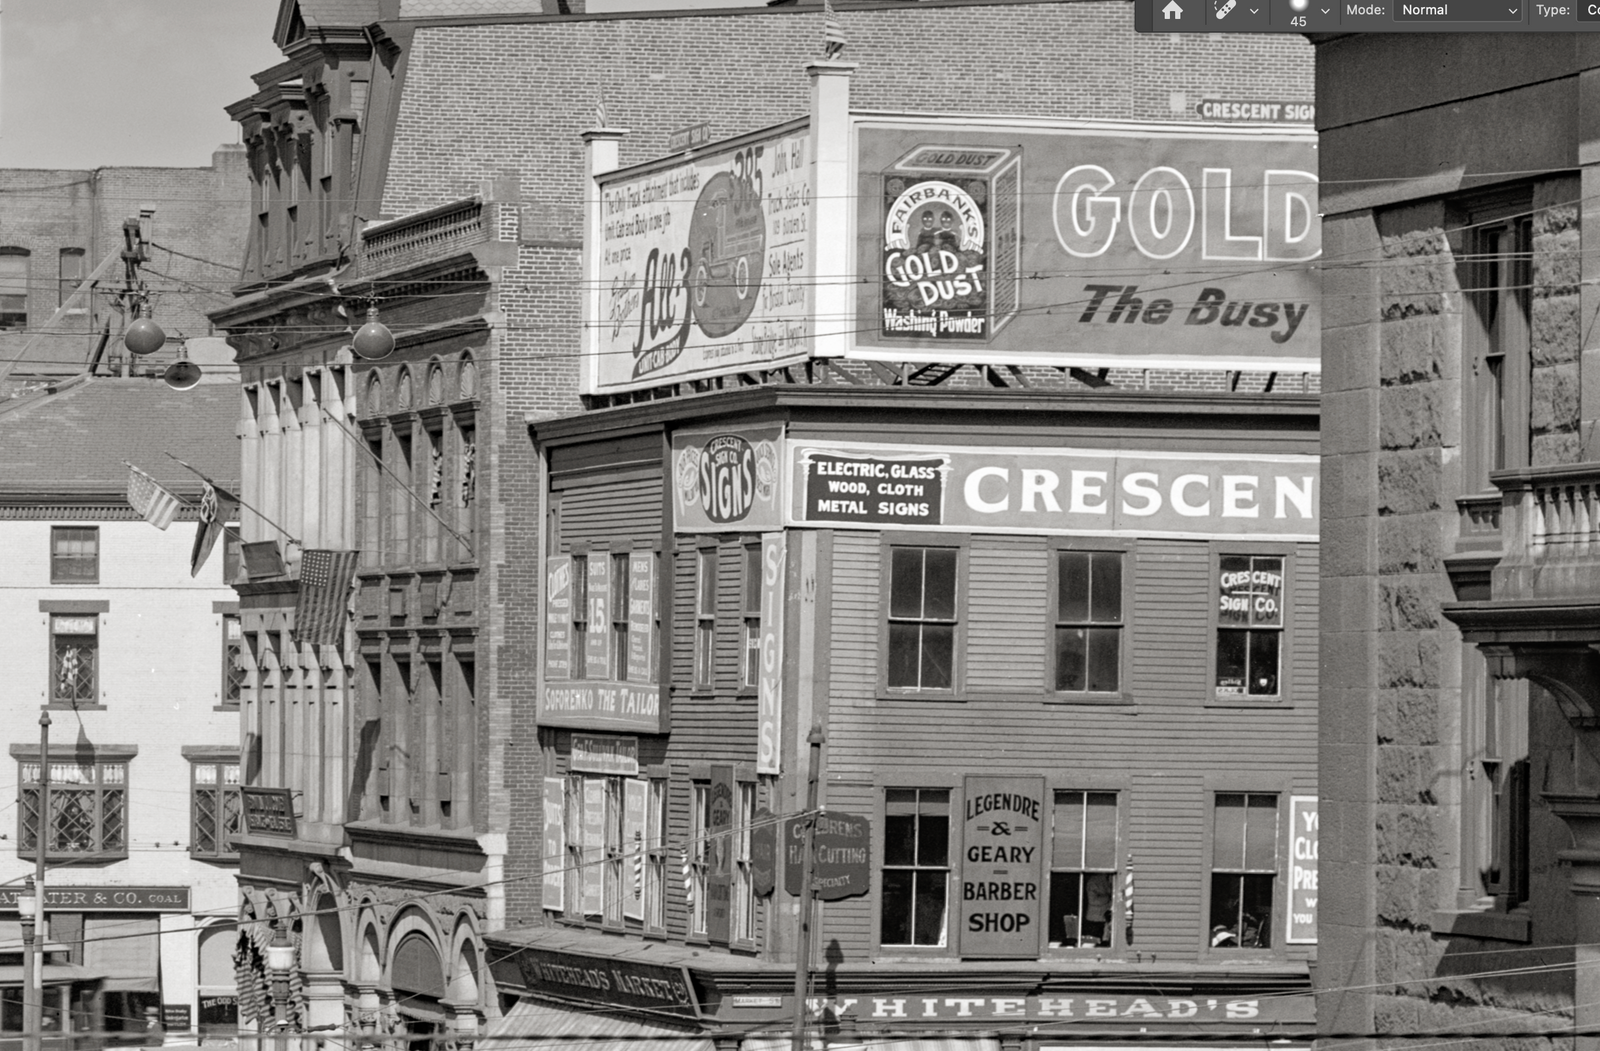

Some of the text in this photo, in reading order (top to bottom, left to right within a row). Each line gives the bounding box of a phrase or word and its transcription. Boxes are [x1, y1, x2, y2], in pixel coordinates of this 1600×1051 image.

[1203, 102, 1281, 119] CRESCENT
[915, 151, 997, 167] GOLD DUST
[891, 186, 979, 240] FAIRBANK'S
[1052, 164, 1322, 262] GOLD
[885, 249, 959, 287] GOLD
[917, 264, 984, 306] DUST
[939, 310, 986, 334] Powder
[1078, 284, 1309, 344] The Busy
[710, 436, 742, 455] CRESCENT
[817, 461, 936, 480] ELECTRIC, GLASS
[701, 448, 753, 519] SIGNS
[828, 480, 924, 497] WOOD, CLOTH
[963, 466, 1315, 519] CRESCEN
[817, 499, 929, 517] METAL SIGNS
[1220, 570, 1282, 588] CRESCENT
[1219, 595, 1279, 612] SIGN CO.
[544, 687, 660, 716] SOFORENKO THE TAILOR
[966, 792, 1040, 822] LEGENDRE
[991, 821, 1012, 837] &
[818, 844, 867, 864] CUTTING
[967, 846, 1036, 863] GEARY
[93, 892, 108, 905] &
[113, 892, 142, 905] CO.
[148, 894, 182, 904] COAL
[963, 882, 1037, 901] BARBER
[968, 912, 1031, 933] SHOP
[1293, 913, 1313, 924] YOU
[529, 957, 674, 1001] WHITEHEAD'S MARKET
[202, 999, 217, 1009] THE
[217, 996, 232, 1005] ODD
[805, 998, 1260, 1020] WHITEHEAD'S
